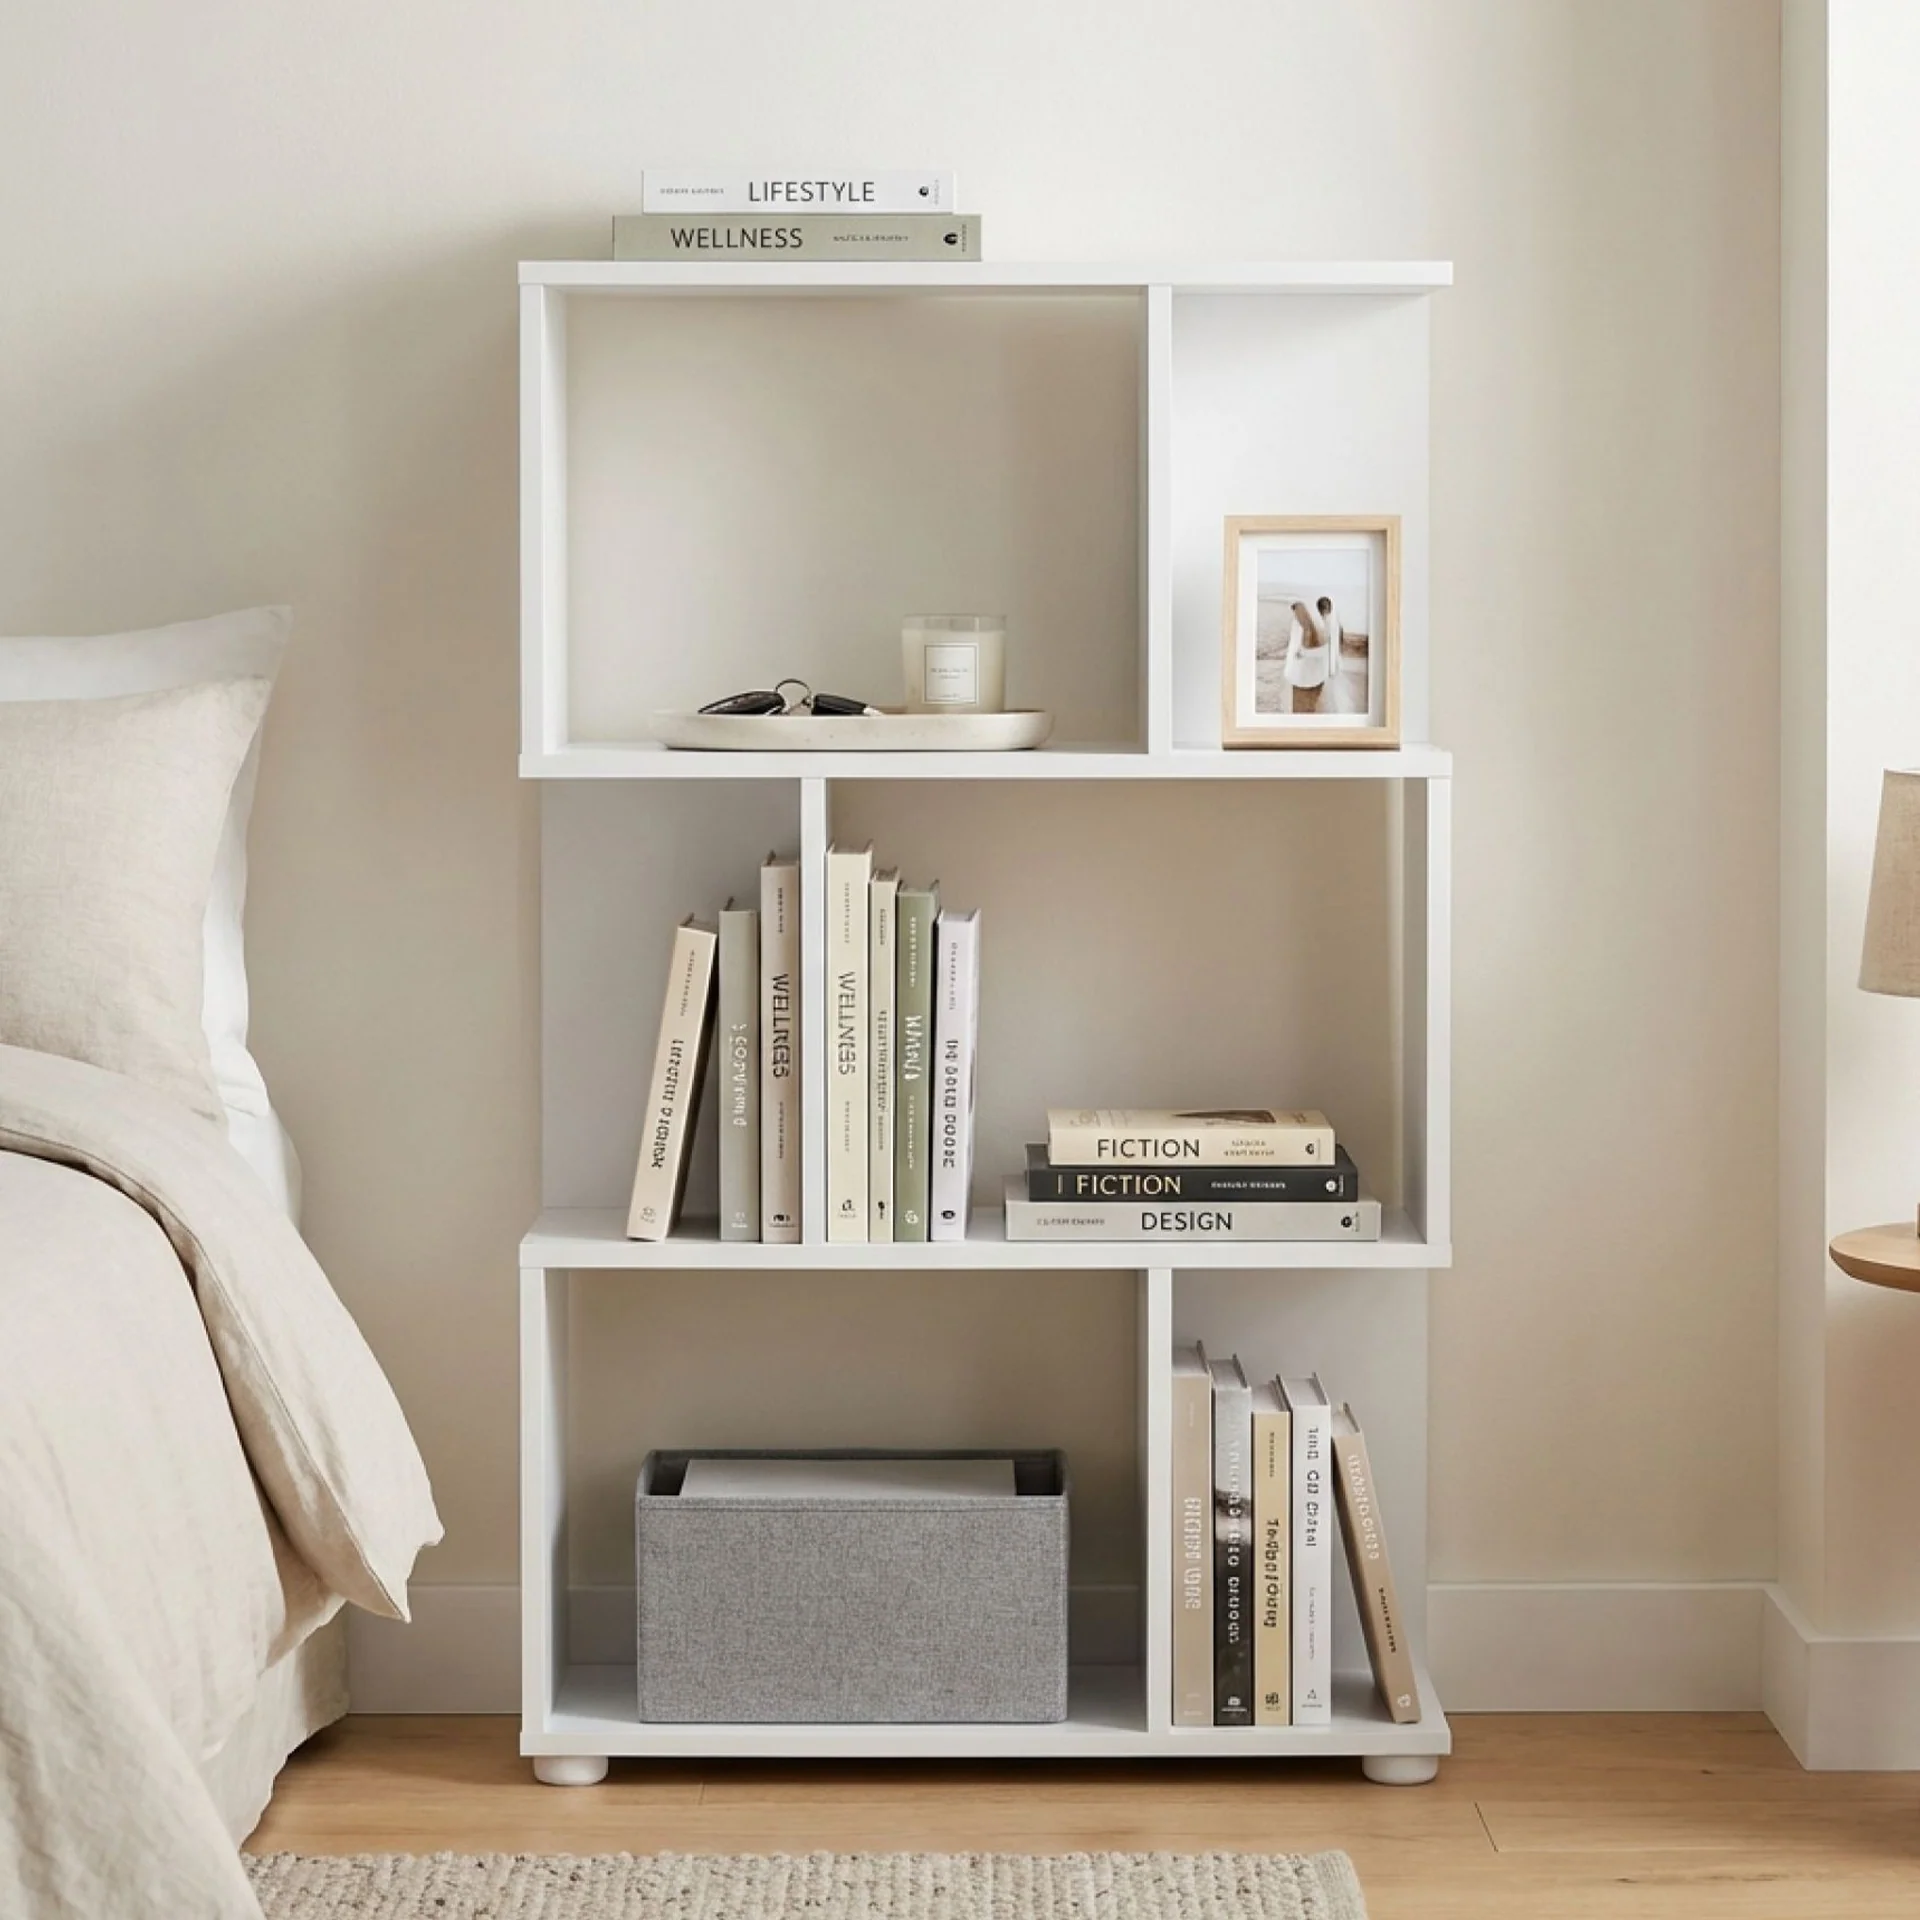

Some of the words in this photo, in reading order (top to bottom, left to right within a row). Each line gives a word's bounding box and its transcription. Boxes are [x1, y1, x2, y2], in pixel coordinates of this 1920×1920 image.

[748, 181, 875, 202] LIFESTYLE
[670, 227, 803, 249] WELLNESS
[1097, 1138, 1200, 1158] FICTION
[1076, 1174, 1181, 1195] FICTION
[1141, 1212, 1232, 1231] DESIGN
